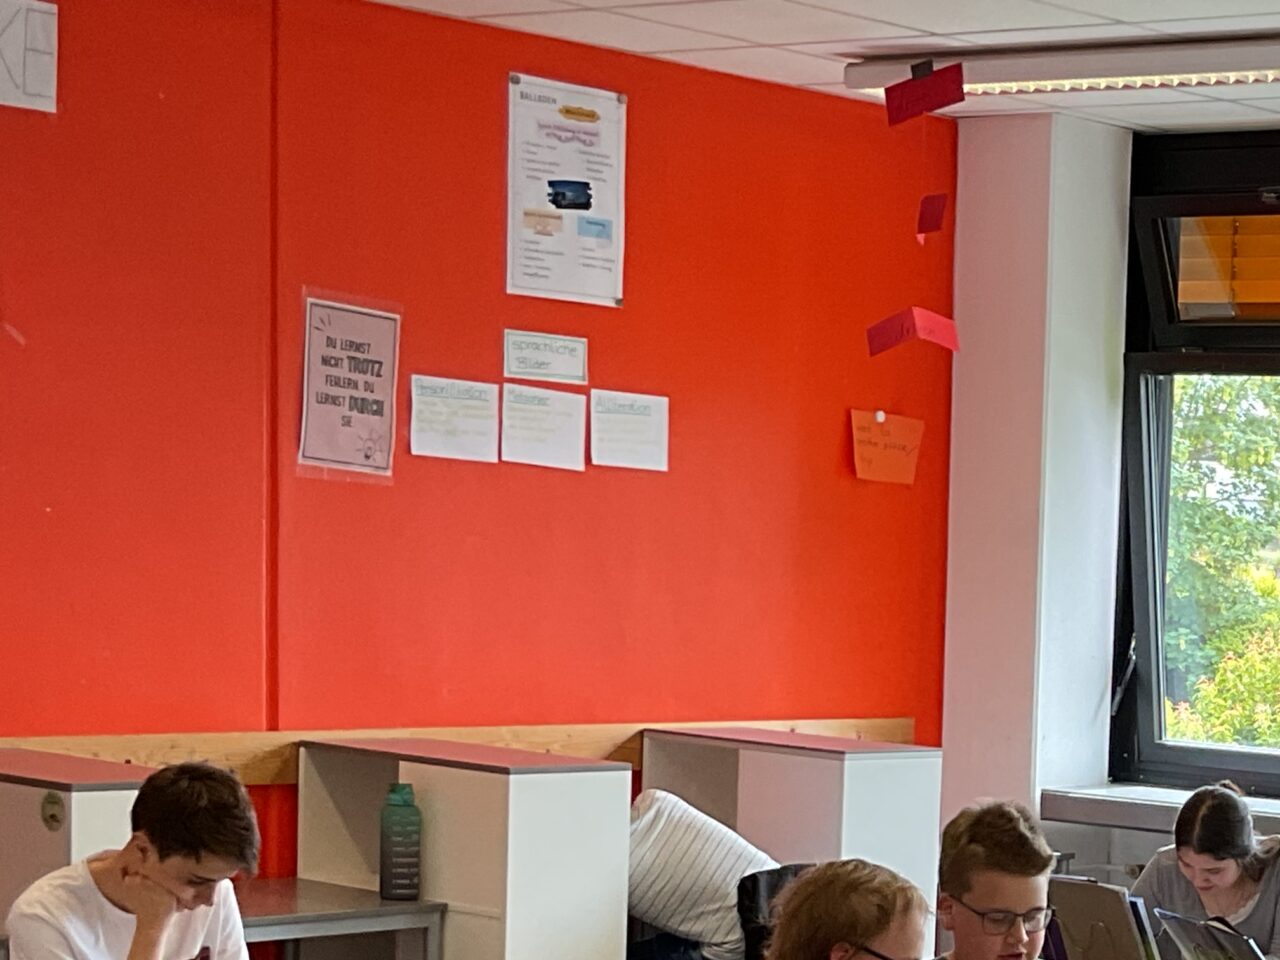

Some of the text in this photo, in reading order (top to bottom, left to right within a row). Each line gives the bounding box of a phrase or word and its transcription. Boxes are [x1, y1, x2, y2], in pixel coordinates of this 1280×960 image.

[326, 335, 371, 354] DU LERNST
[346, 355, 384, 378] TROTZ
[364, 381, 375, 393] DU
[316, 391, 384, 417] LERNST DURCH
